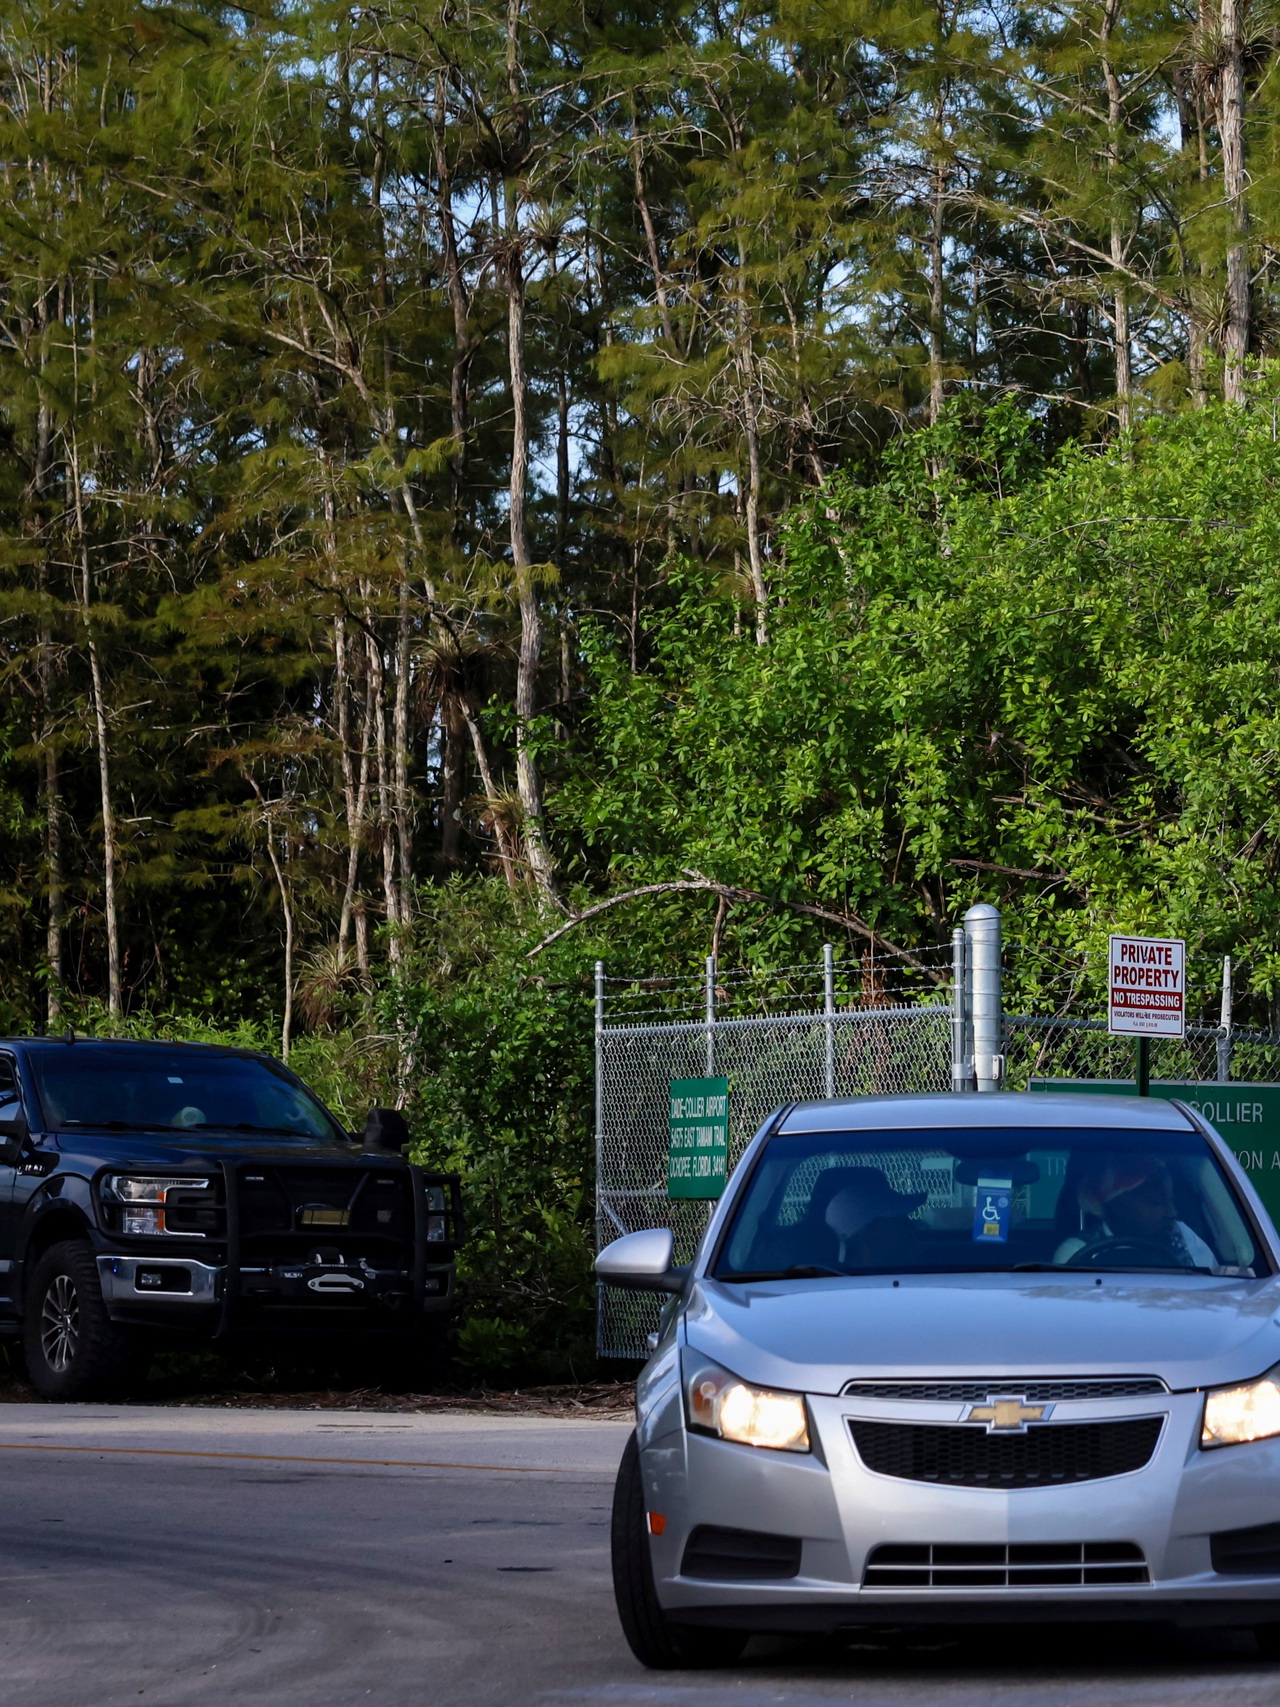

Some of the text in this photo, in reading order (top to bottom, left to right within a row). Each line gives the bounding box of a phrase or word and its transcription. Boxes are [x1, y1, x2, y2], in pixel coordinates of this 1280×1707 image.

[1121, 944, 1172, 965] PRIVATE
[1114, 966, 1179, 988] PROPERTY
[1113, 991, 1180, 1008] NO TRESPASSING
[1114, 1010, 1135, 1018] VIOLATORS
[1151, 1013, 1180, 1021] PROSECUTED
[671, 1095, 727, 1118] DADE-COLLIER AIRPORT
[684, 1126, 695, 1148] EAST
[696, 1126, 713, 1147] TAMIAMI
[713, 1125, 725, 1146] TRAIL
[692, 1155, 712, 1177] FLORIDA
